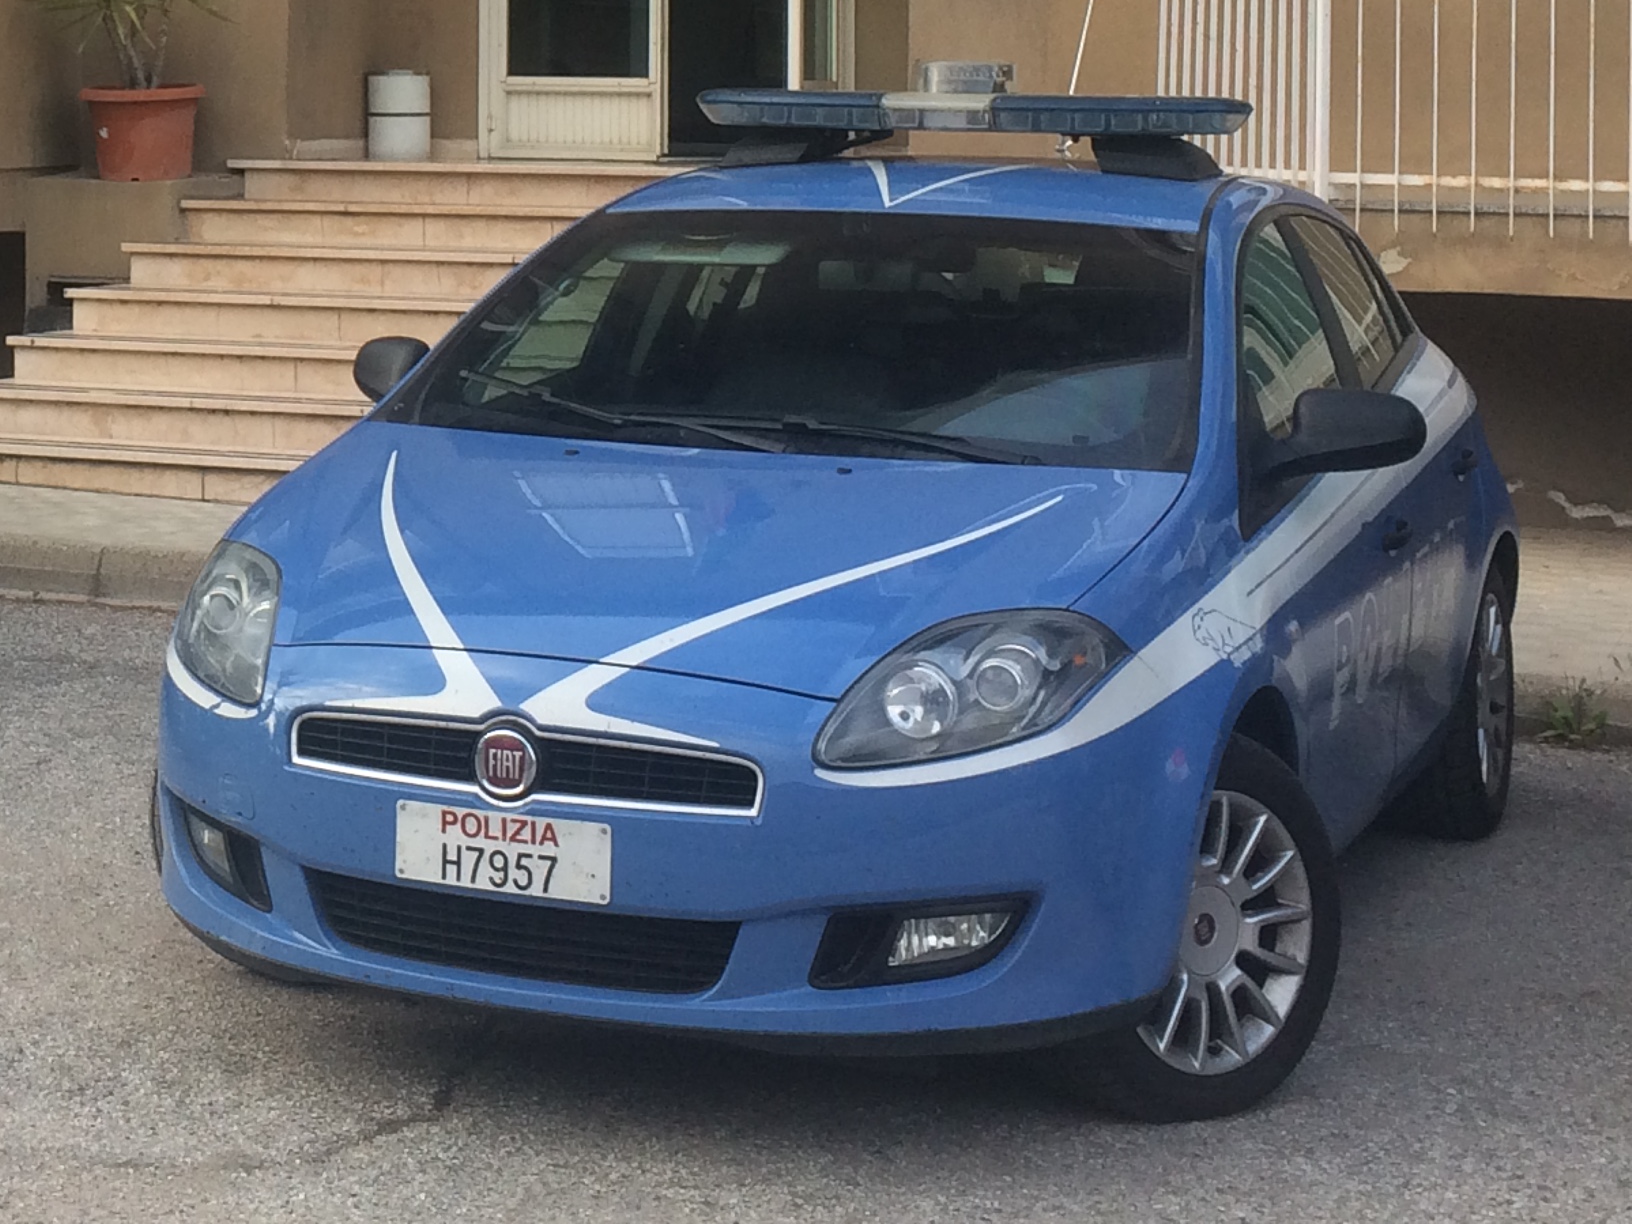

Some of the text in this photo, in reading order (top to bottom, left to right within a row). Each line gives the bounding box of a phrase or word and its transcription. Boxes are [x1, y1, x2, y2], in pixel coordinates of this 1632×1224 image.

[488, 748, 523, 780] FIAT
[440, 809, 560, 847] POLIZIA
[441, 842, 558, 894] H7957
